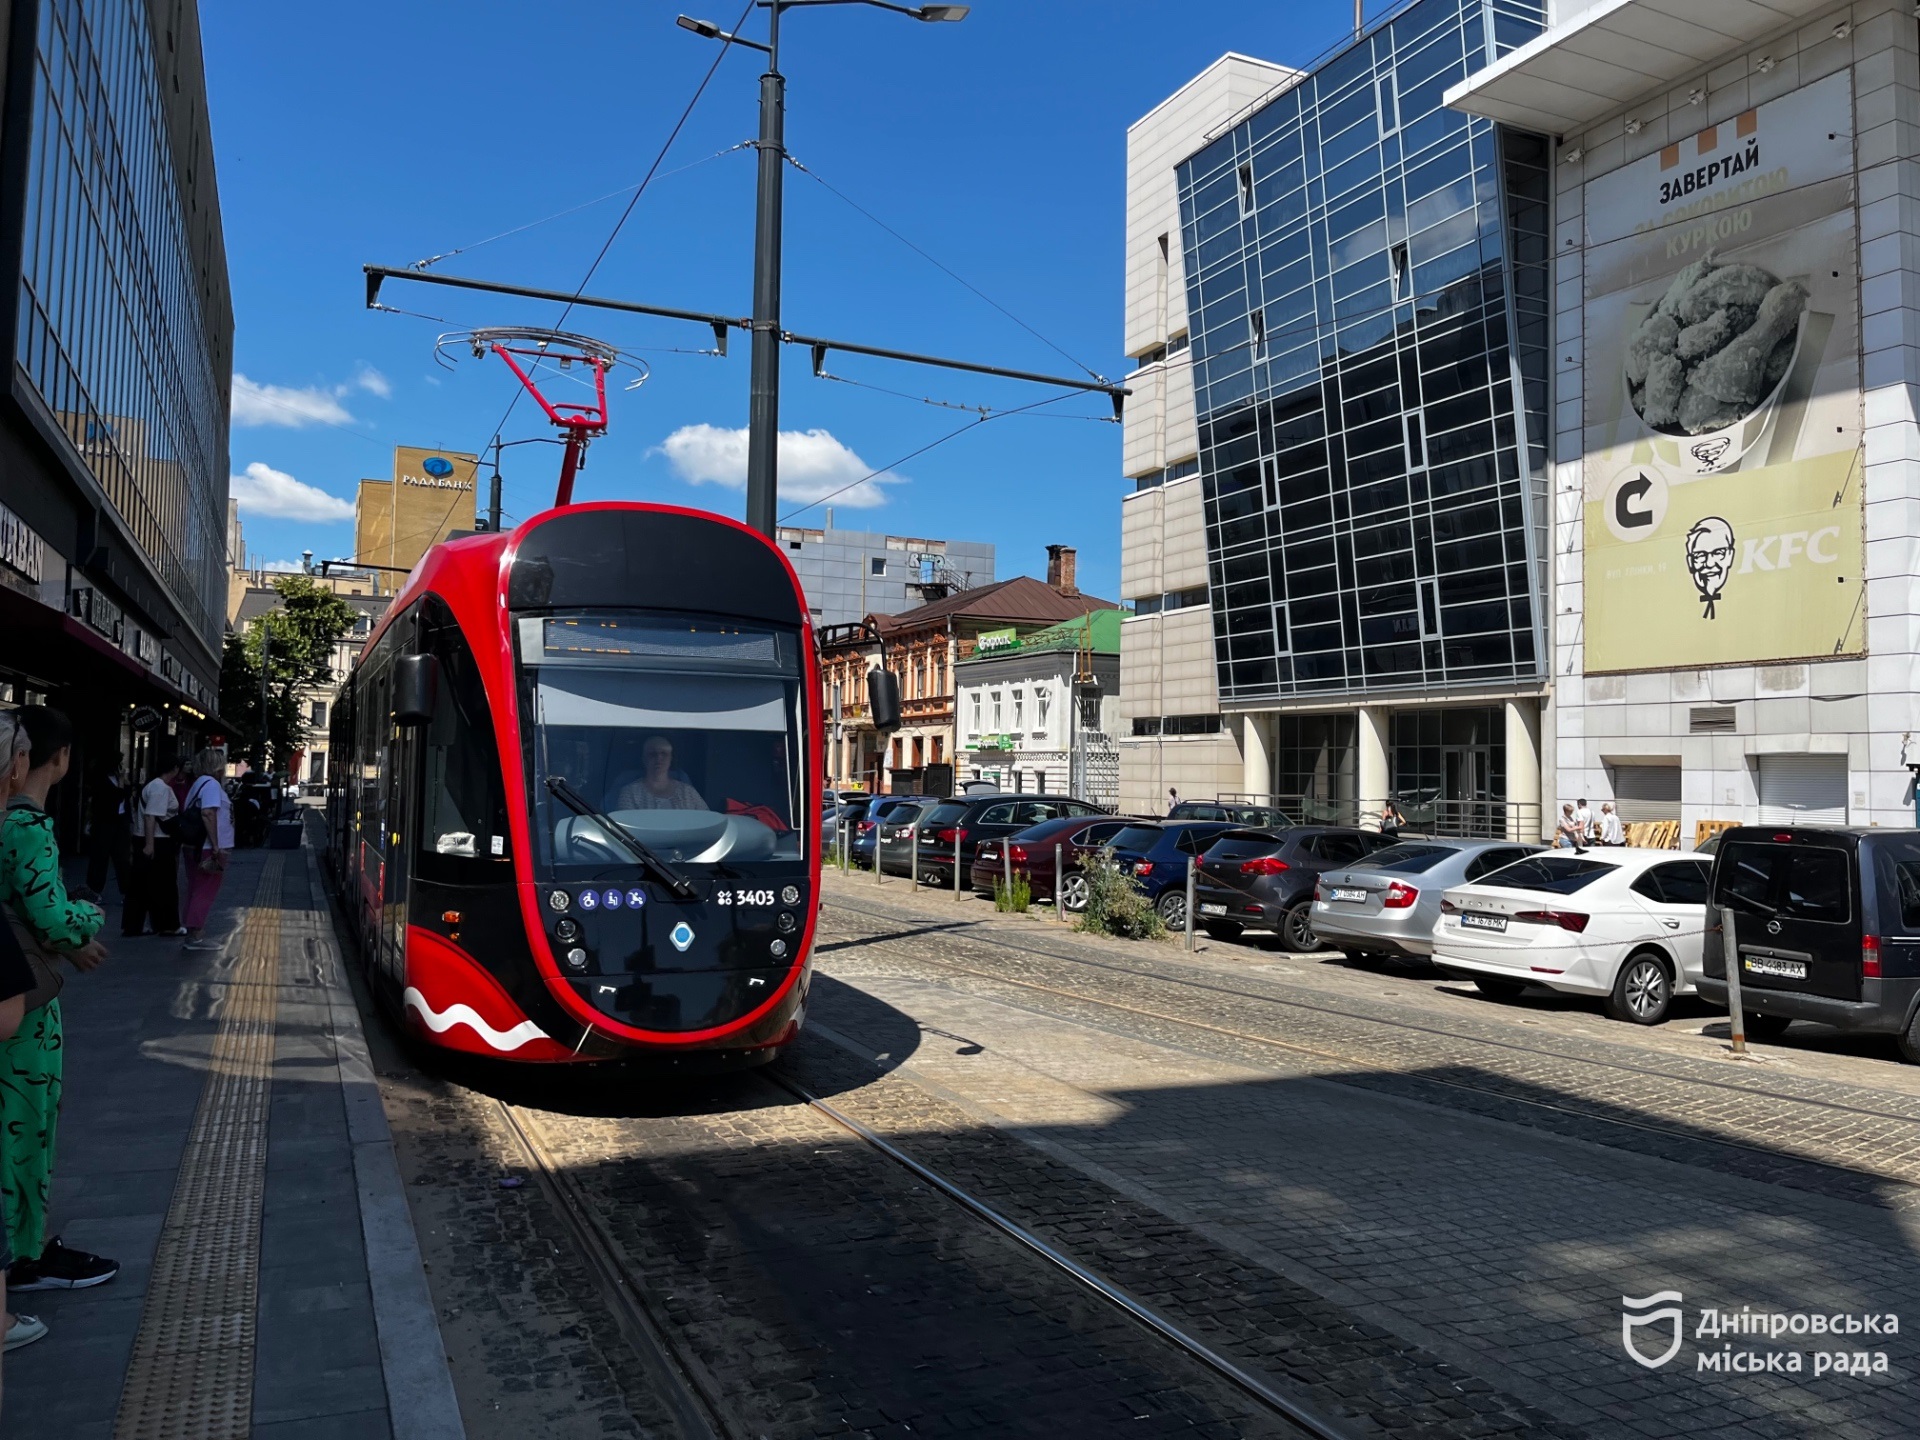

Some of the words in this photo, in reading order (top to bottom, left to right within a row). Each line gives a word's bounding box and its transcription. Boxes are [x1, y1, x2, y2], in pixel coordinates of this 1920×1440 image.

[1659, 138, 1759, 205] ЗАВЕРТАЙ
[1666, 208, 1752, 259] КУРКОЮ
[403, 474, 472, 490] РАДАБАНК
[1737, 526, 1840, 575] KFC
[736, 889, 775, 906] 3403
[1751, 957, 1764, 969] BB
[1790, 962, 1803, 975] AX
